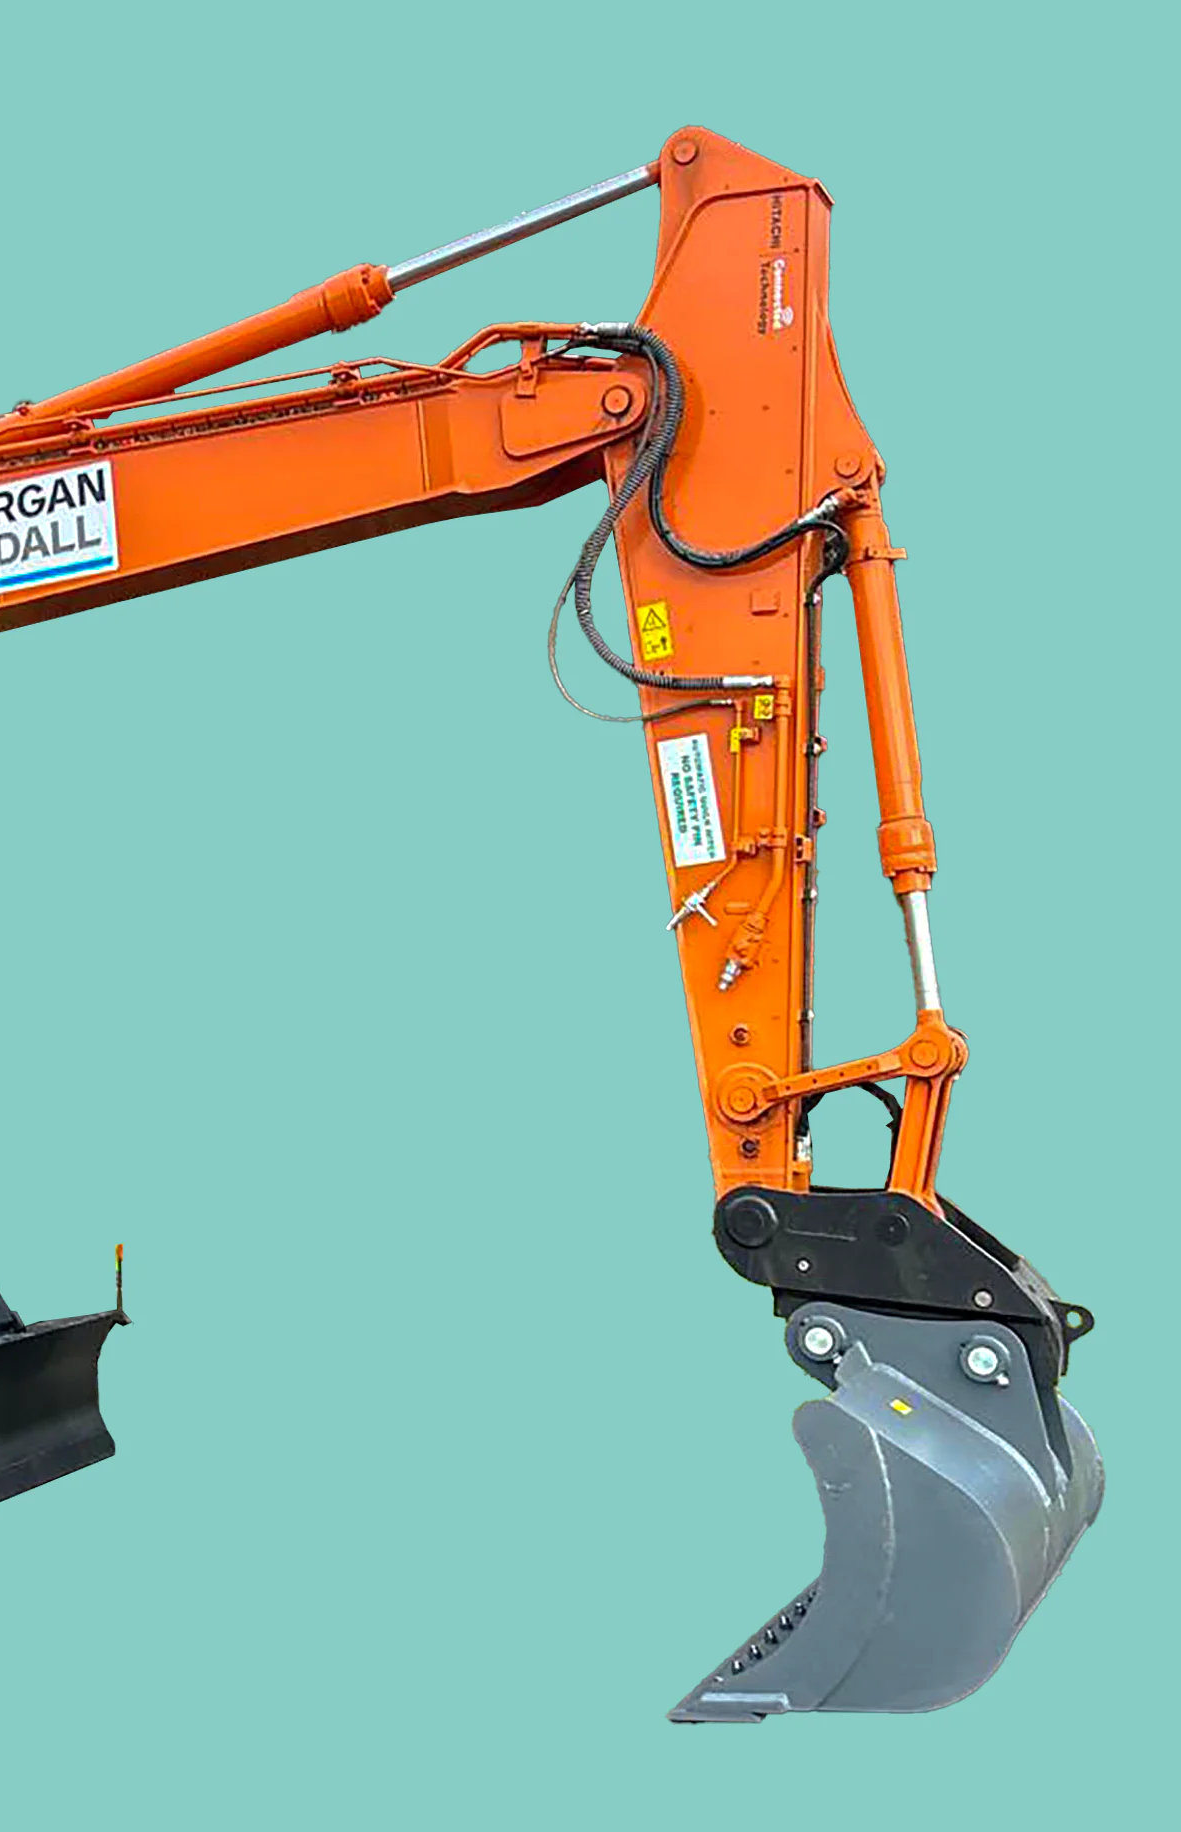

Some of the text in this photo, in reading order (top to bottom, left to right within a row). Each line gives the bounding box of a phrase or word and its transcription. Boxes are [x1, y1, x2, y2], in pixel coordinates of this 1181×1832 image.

[771, 195, 782, 248] HITACHI
[758, 261, 771, 334] Technology
[671, 772, 688, 834] REQUIRED
[681, 755, 703, 847] NO SAFETY PIN
